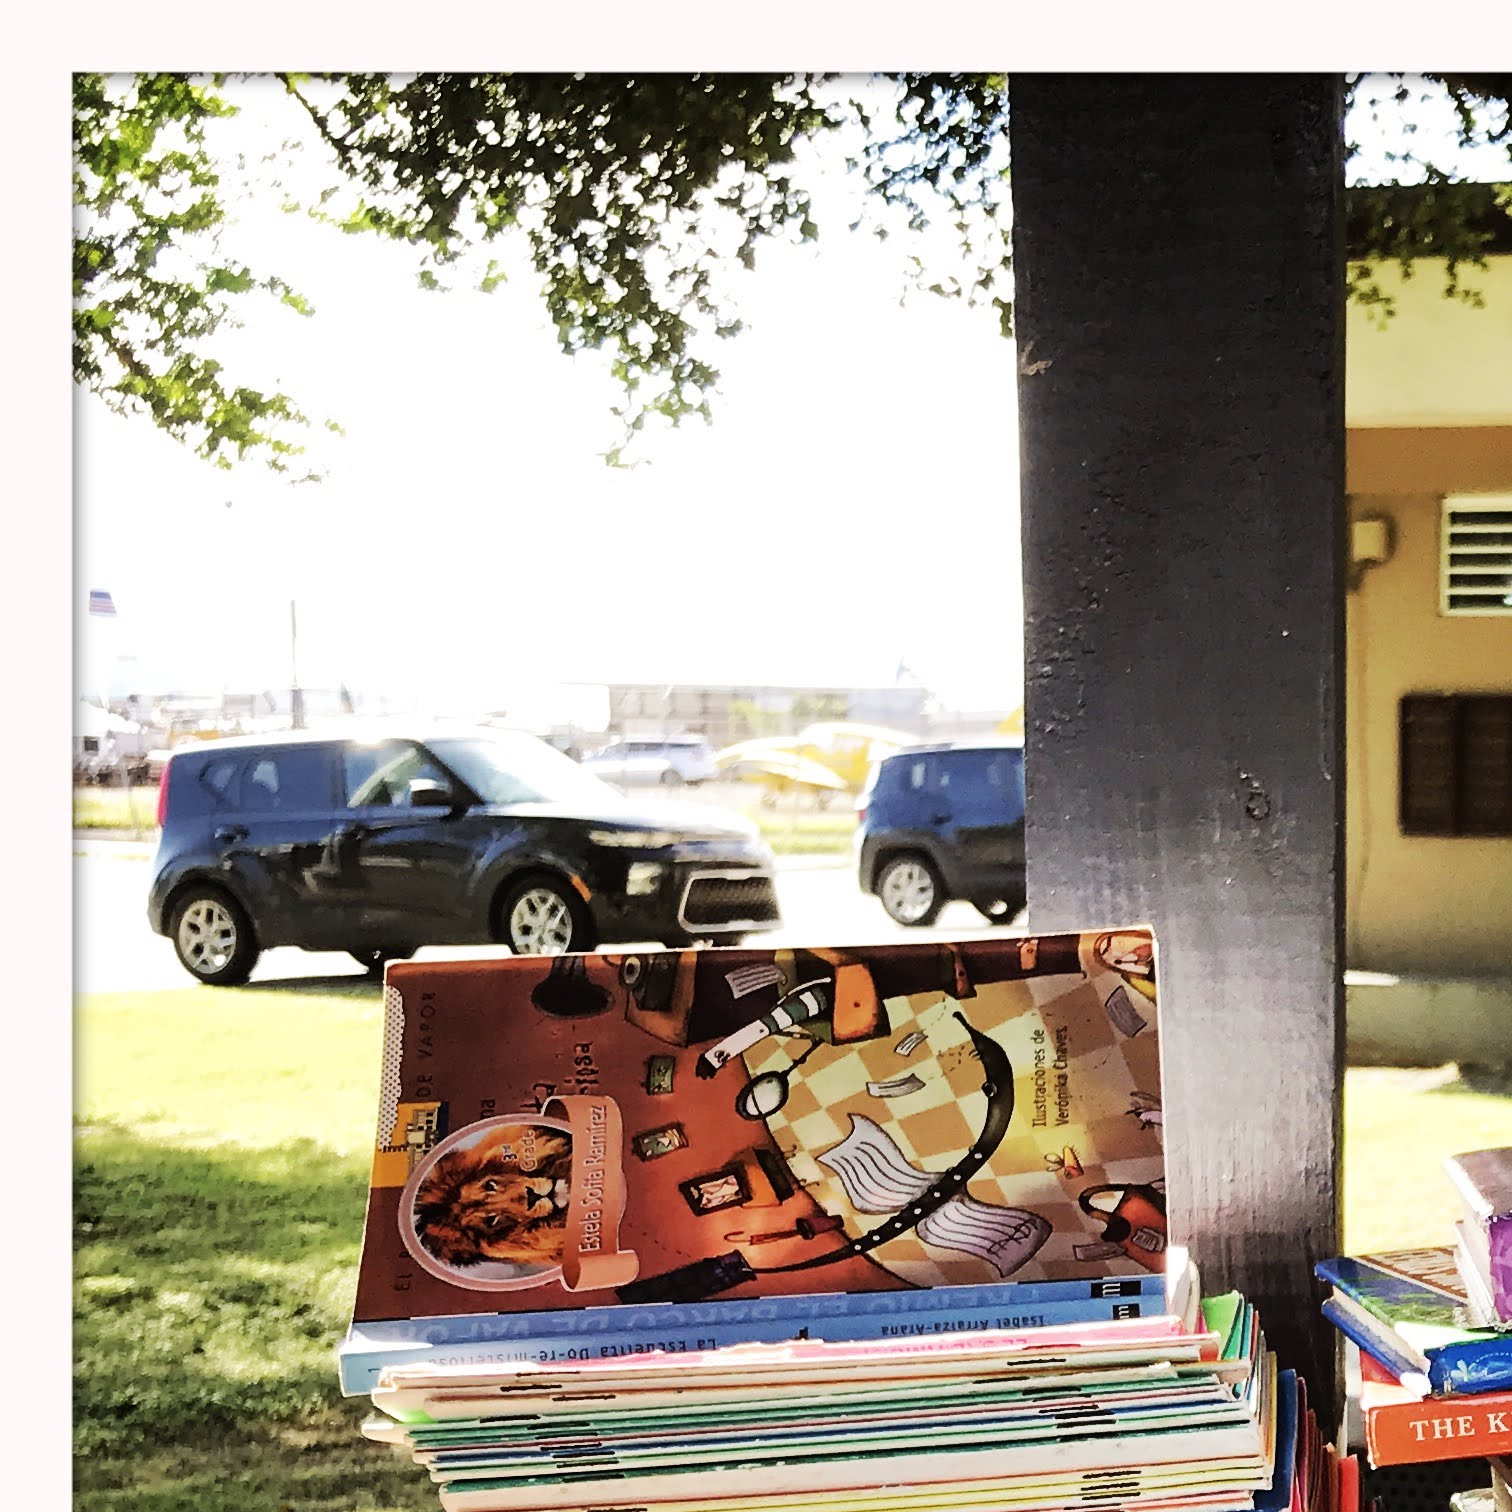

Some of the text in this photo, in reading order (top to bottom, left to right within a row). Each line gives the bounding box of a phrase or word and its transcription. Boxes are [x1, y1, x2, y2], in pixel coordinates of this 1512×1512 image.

[417, 991, 437, 1060] VAPOR
[1052, 1024, 1068, 1071] Chaves
[1031, 1029, 1047, 1128] Ilustraciones de
[519, 1128, 537, 1173] Grade
[578, 1209, 602, 1253] Estela
[999, 1314, 1046, 1329] Isabel
[1409, 1412, 1476, 1443] THE
